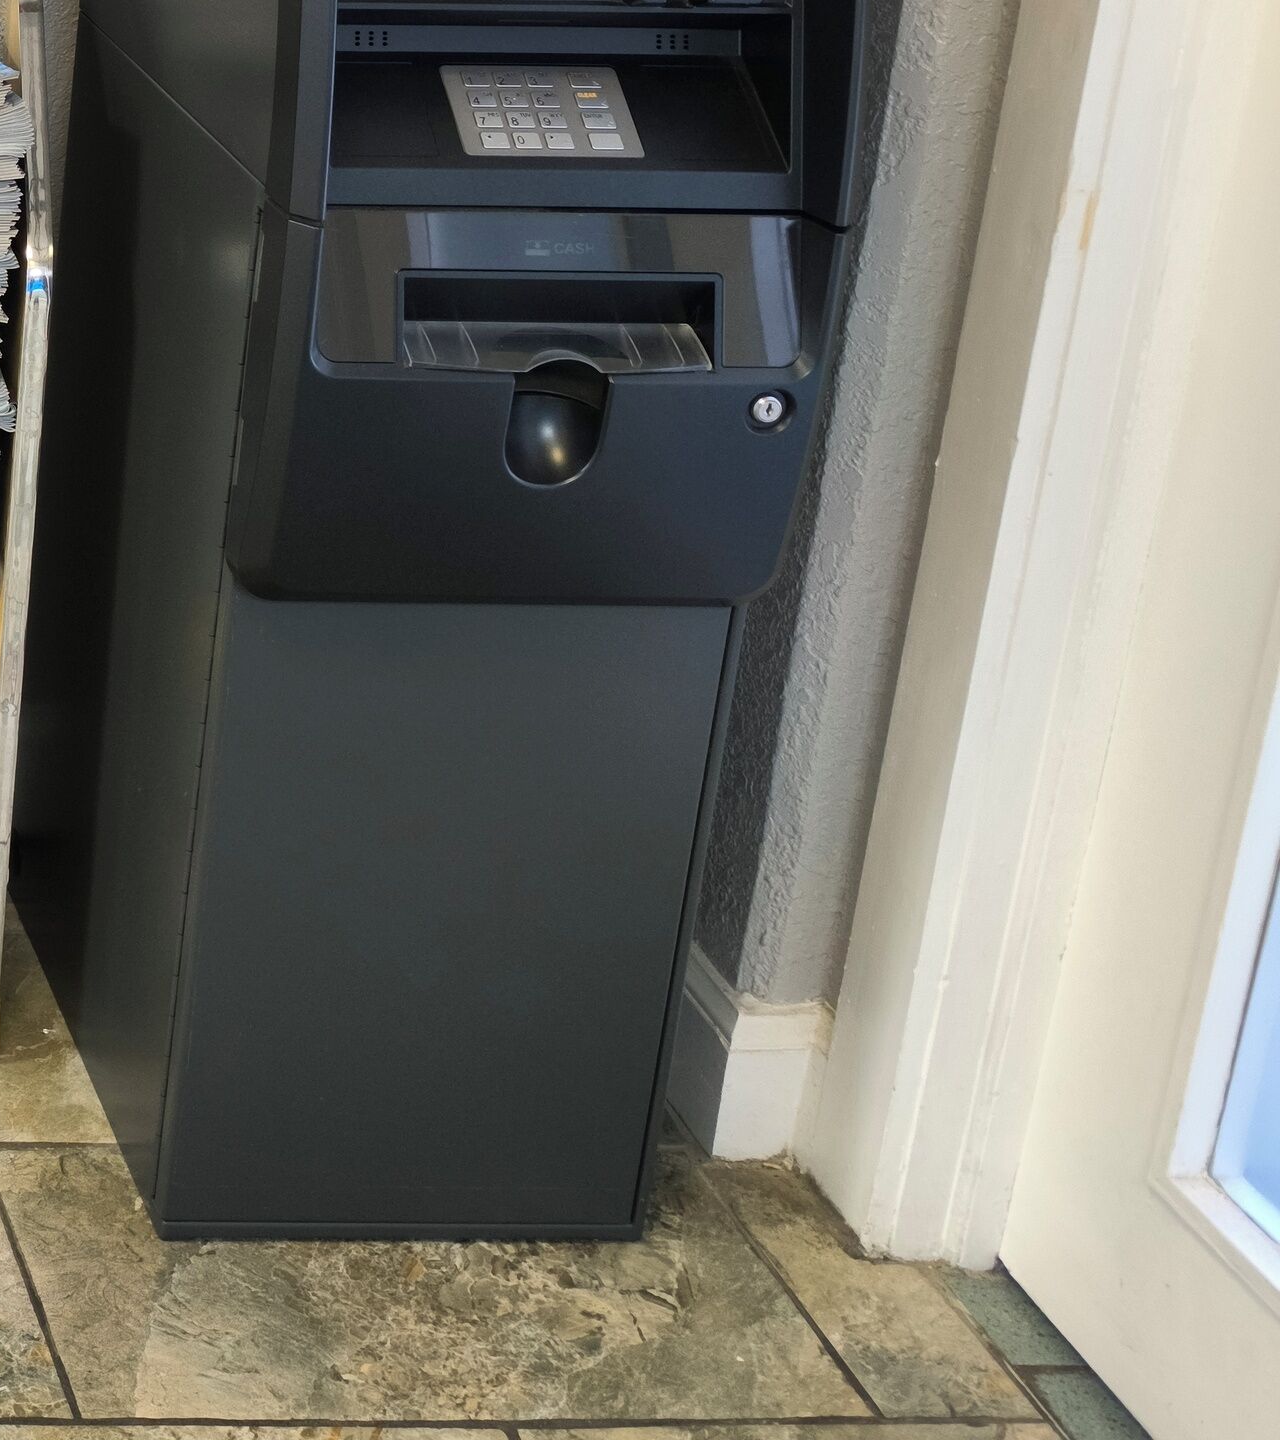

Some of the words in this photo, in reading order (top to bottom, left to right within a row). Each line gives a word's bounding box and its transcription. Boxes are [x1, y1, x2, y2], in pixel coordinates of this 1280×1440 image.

[466, 76, 473, 85] 1
[497, 76, 505, 85] 2
[530, 76, 538, 85] 3
[472, 96, 480, 105] 4
[504, 96, 511, 105] 5
[536, 96, 545, 106] 6
[479, 116, 487, 125] 7
[510, 116, 519, 126] 8
[542, 116, 551, 126] 9
[554, 242, 594, 255] CASH
